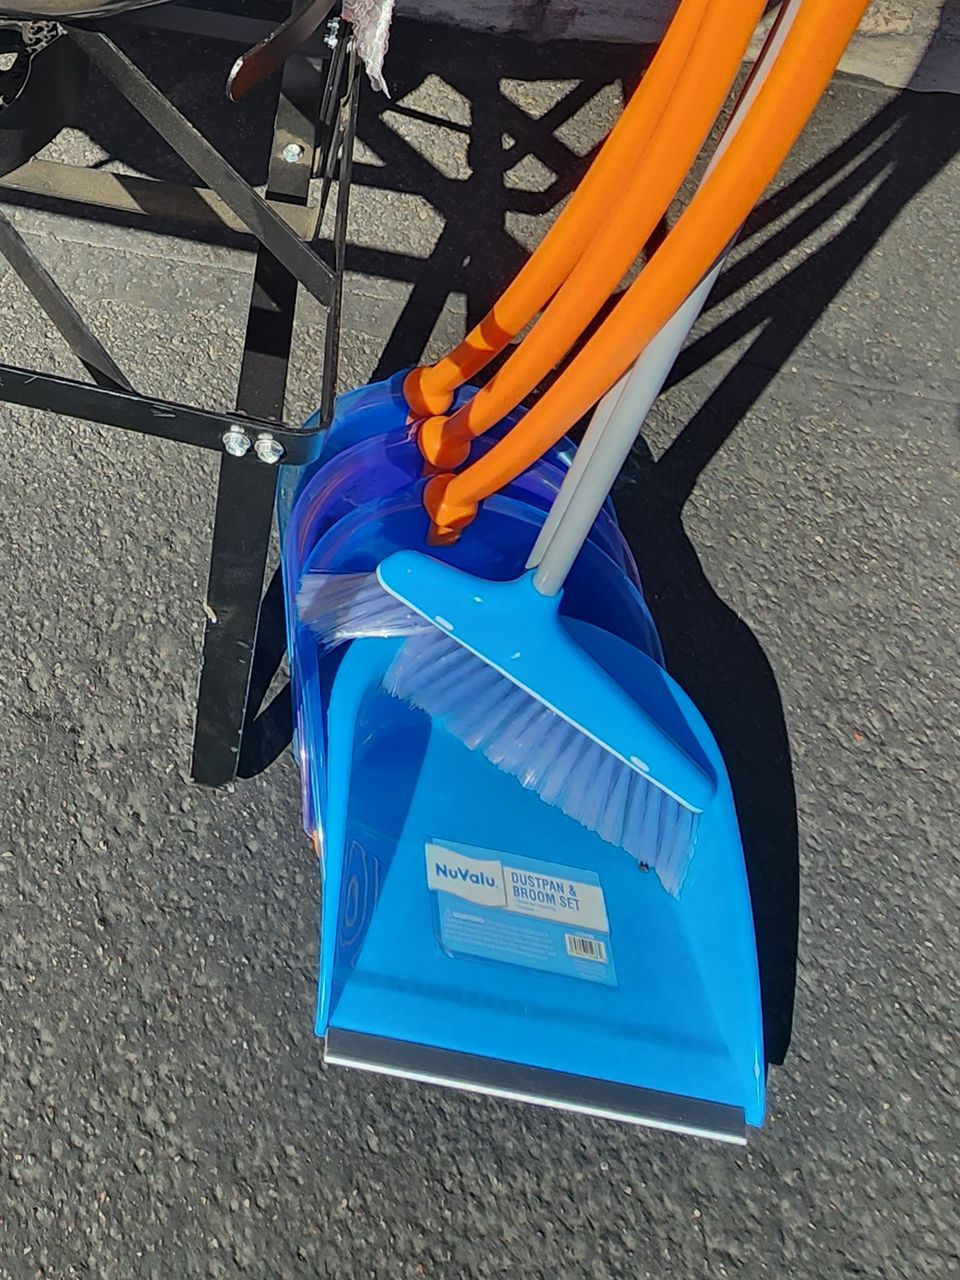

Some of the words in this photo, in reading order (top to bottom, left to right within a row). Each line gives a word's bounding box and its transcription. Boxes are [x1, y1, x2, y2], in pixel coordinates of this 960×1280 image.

[435, 862, 495, 888] NuValu
[511, 872, 564, 894] DUSTPAN
[569, 884, 577, 897] &
[512, 886, 556, 906] BROOM
[559, 896, 581, 911] SET
